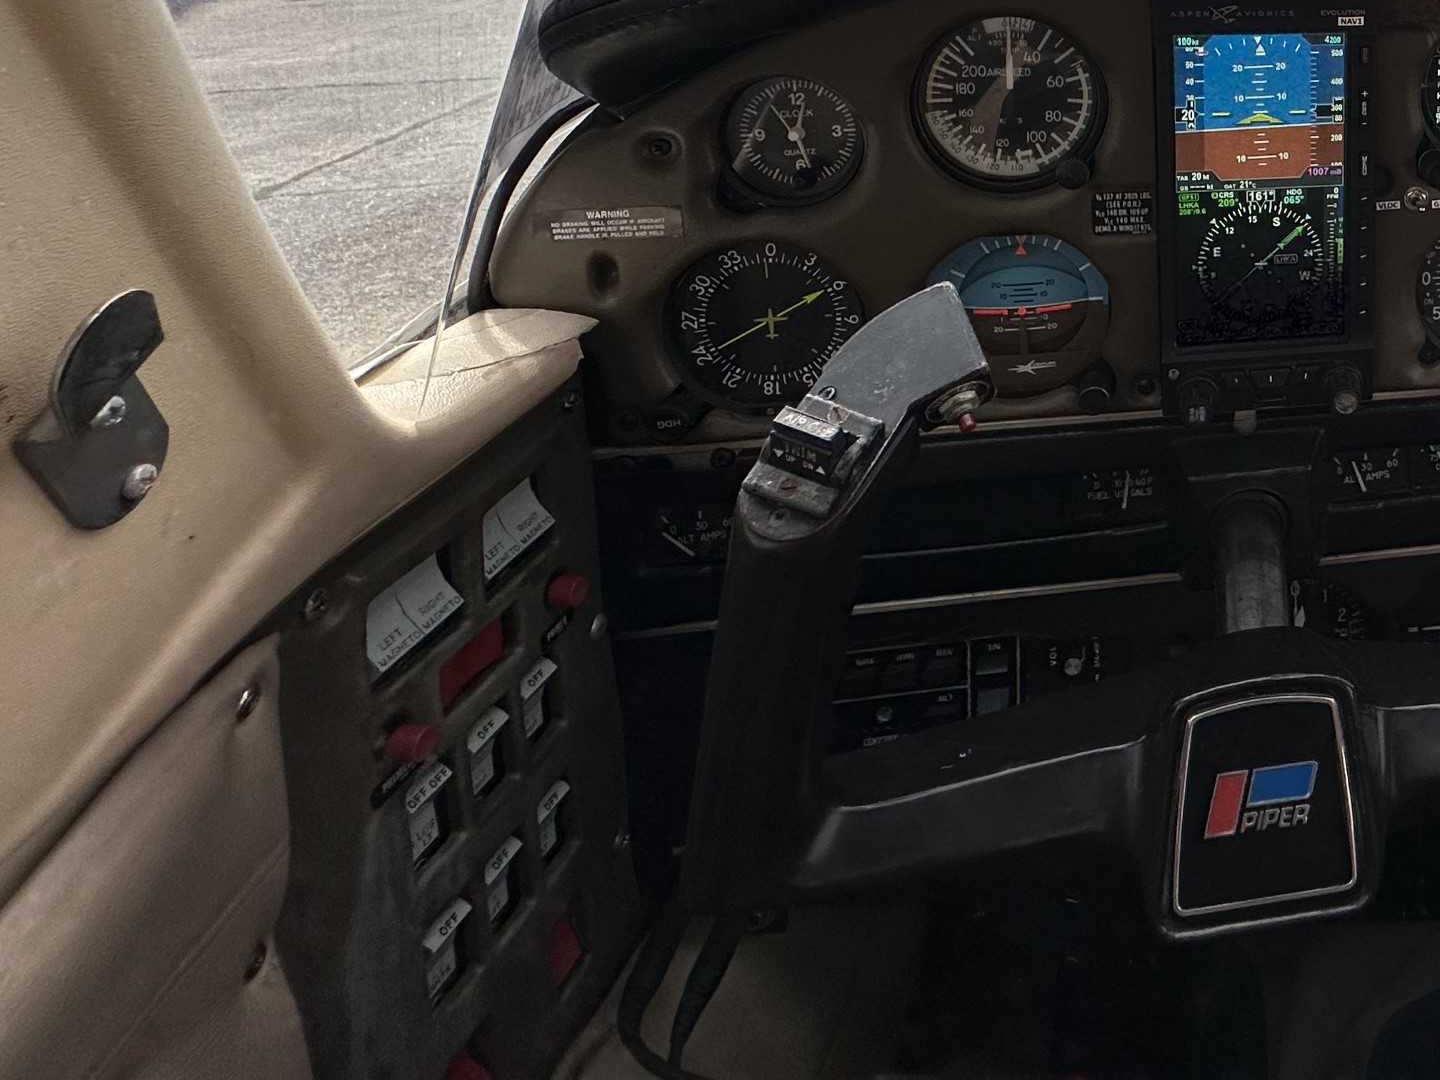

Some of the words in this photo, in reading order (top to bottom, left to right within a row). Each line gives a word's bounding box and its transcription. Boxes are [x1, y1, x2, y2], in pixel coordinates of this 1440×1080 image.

[1023, 51, 1041, 63] 40
[961, 65, 986, 77] 200
[1047, 76, 1064, 88] 60
[955, 83, 975, 95] 180
[788, 92, 805, 105] 12
[780, 109, 814, 118] CLOCK
[958, 109, 973, 118] 160
[1045, 111, 1062, 122] 80
[755, 129, 765, 141] 9
[831, 125, 842, 138] 3
[970, 125, 984, 134] 140
[996, 138, 1009, 147] 120
[1026, 131, 1047, 143] 100
[1378, 201, 1399, 210] VLOC
[586, 209, 630, 219] WARNING
[765, 243, 776, 256] 0
[718, 250, 742, 269] 33
[805, 253, 817, 266] 3
[689, 275, 711, 295] 30
[834, 280, 847, 291] 6
[1421, 273, 1431, 285] 0
[681, 311, 698, 330] 27
[844, 314, 859, 324] 9
[691, 346, 713, 366] 24
[722, 373, 742, 388] 21
[763, 381, 782, 396] 18
[657, 419, 681, 430] HDG
[516, 512, 539, 532] RIGHT
[520, 516, 553, 545] MAGNETO
[700, 530, 727, 542] AMPS
[485, 541, 504, 561] LEFT
[486, 545, 521, 576] MAGNETO
[418, 591, 445, 615] RIGHT
[423, 595, 461, 629] MAGNETO
[1338, 608, 1346, 620] 2
[377, 628, 404, 652] LEFT
[377, 630, 422, 668] MAGNETO
[527, 669, 544, 687] OFF
[477, 721, 496, 739] OFF
[407, 787, 428, 809] OFF
[428, 767, 449, 788] OFF
[544, 792, 560, 811] OFF
[1239, 803, 1311, 834] PIPER
[491, 848, 510, 870] OFF
[438, 912, 459, 936] OFF
